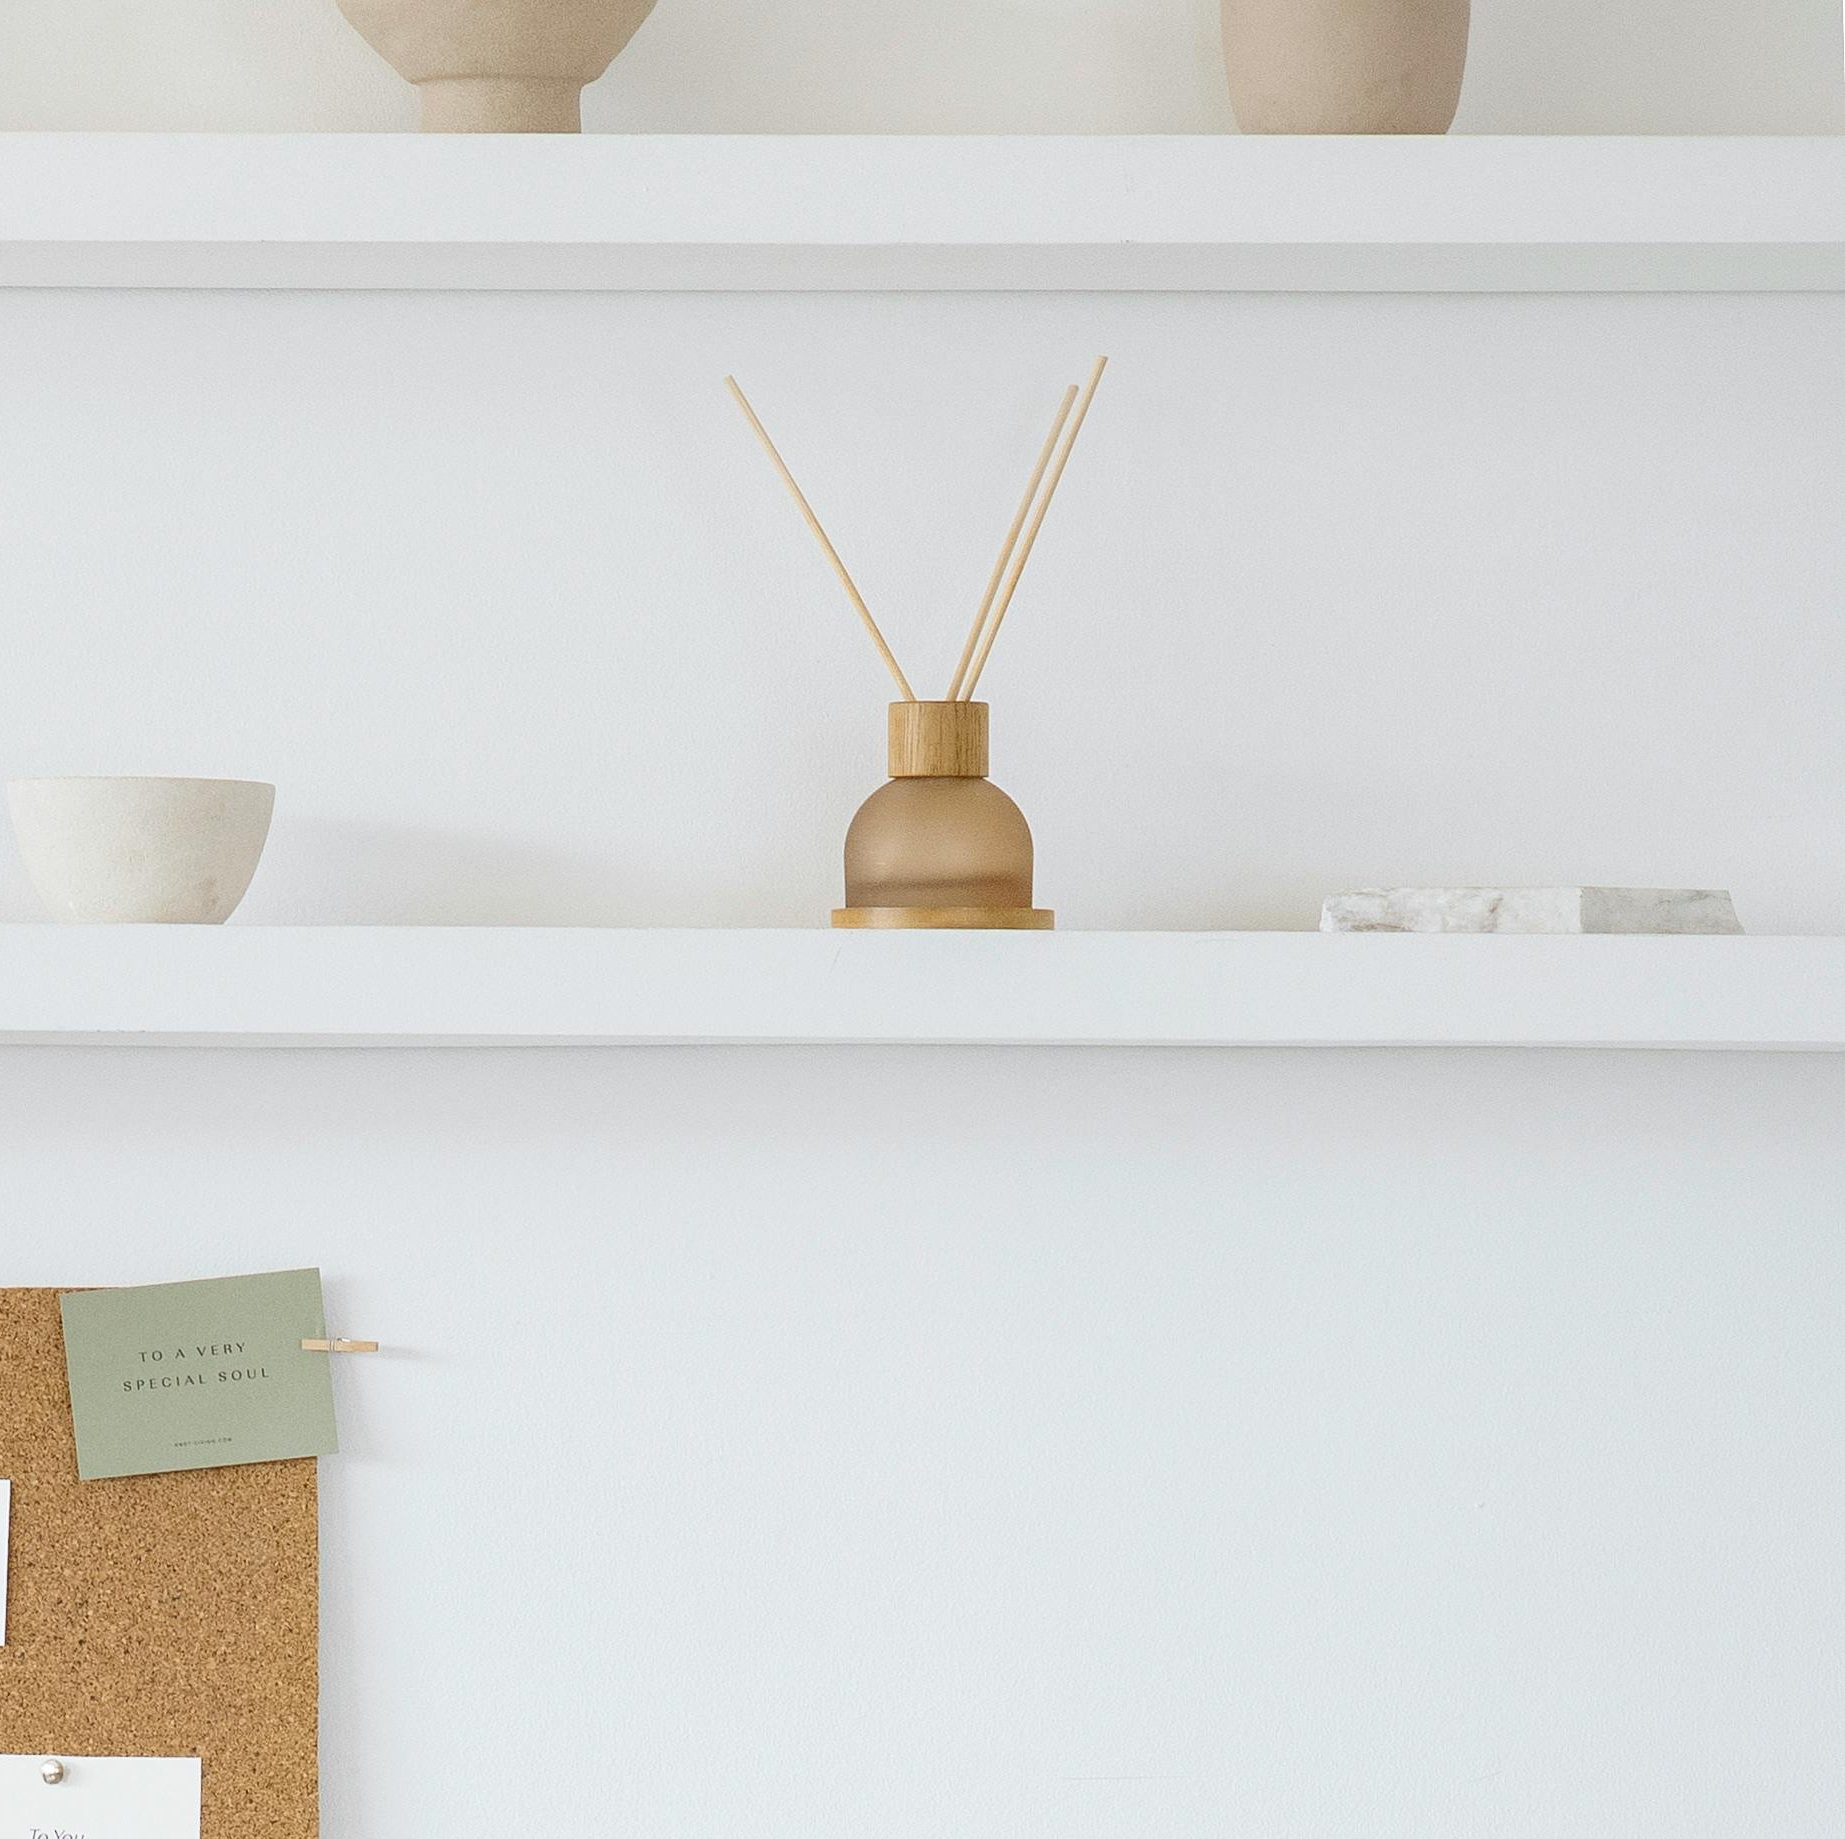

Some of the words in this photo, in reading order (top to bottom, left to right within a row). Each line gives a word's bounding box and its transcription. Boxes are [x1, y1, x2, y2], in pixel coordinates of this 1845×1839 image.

[138, 1350, 163, 1363] TO
[174, 1348, 186, 1360] A
[196, 1342, 246, 1358] VERY
[122, 1373, 208, 1393] SPECIAL
[217, 1367, 270, 1383] SOUL
